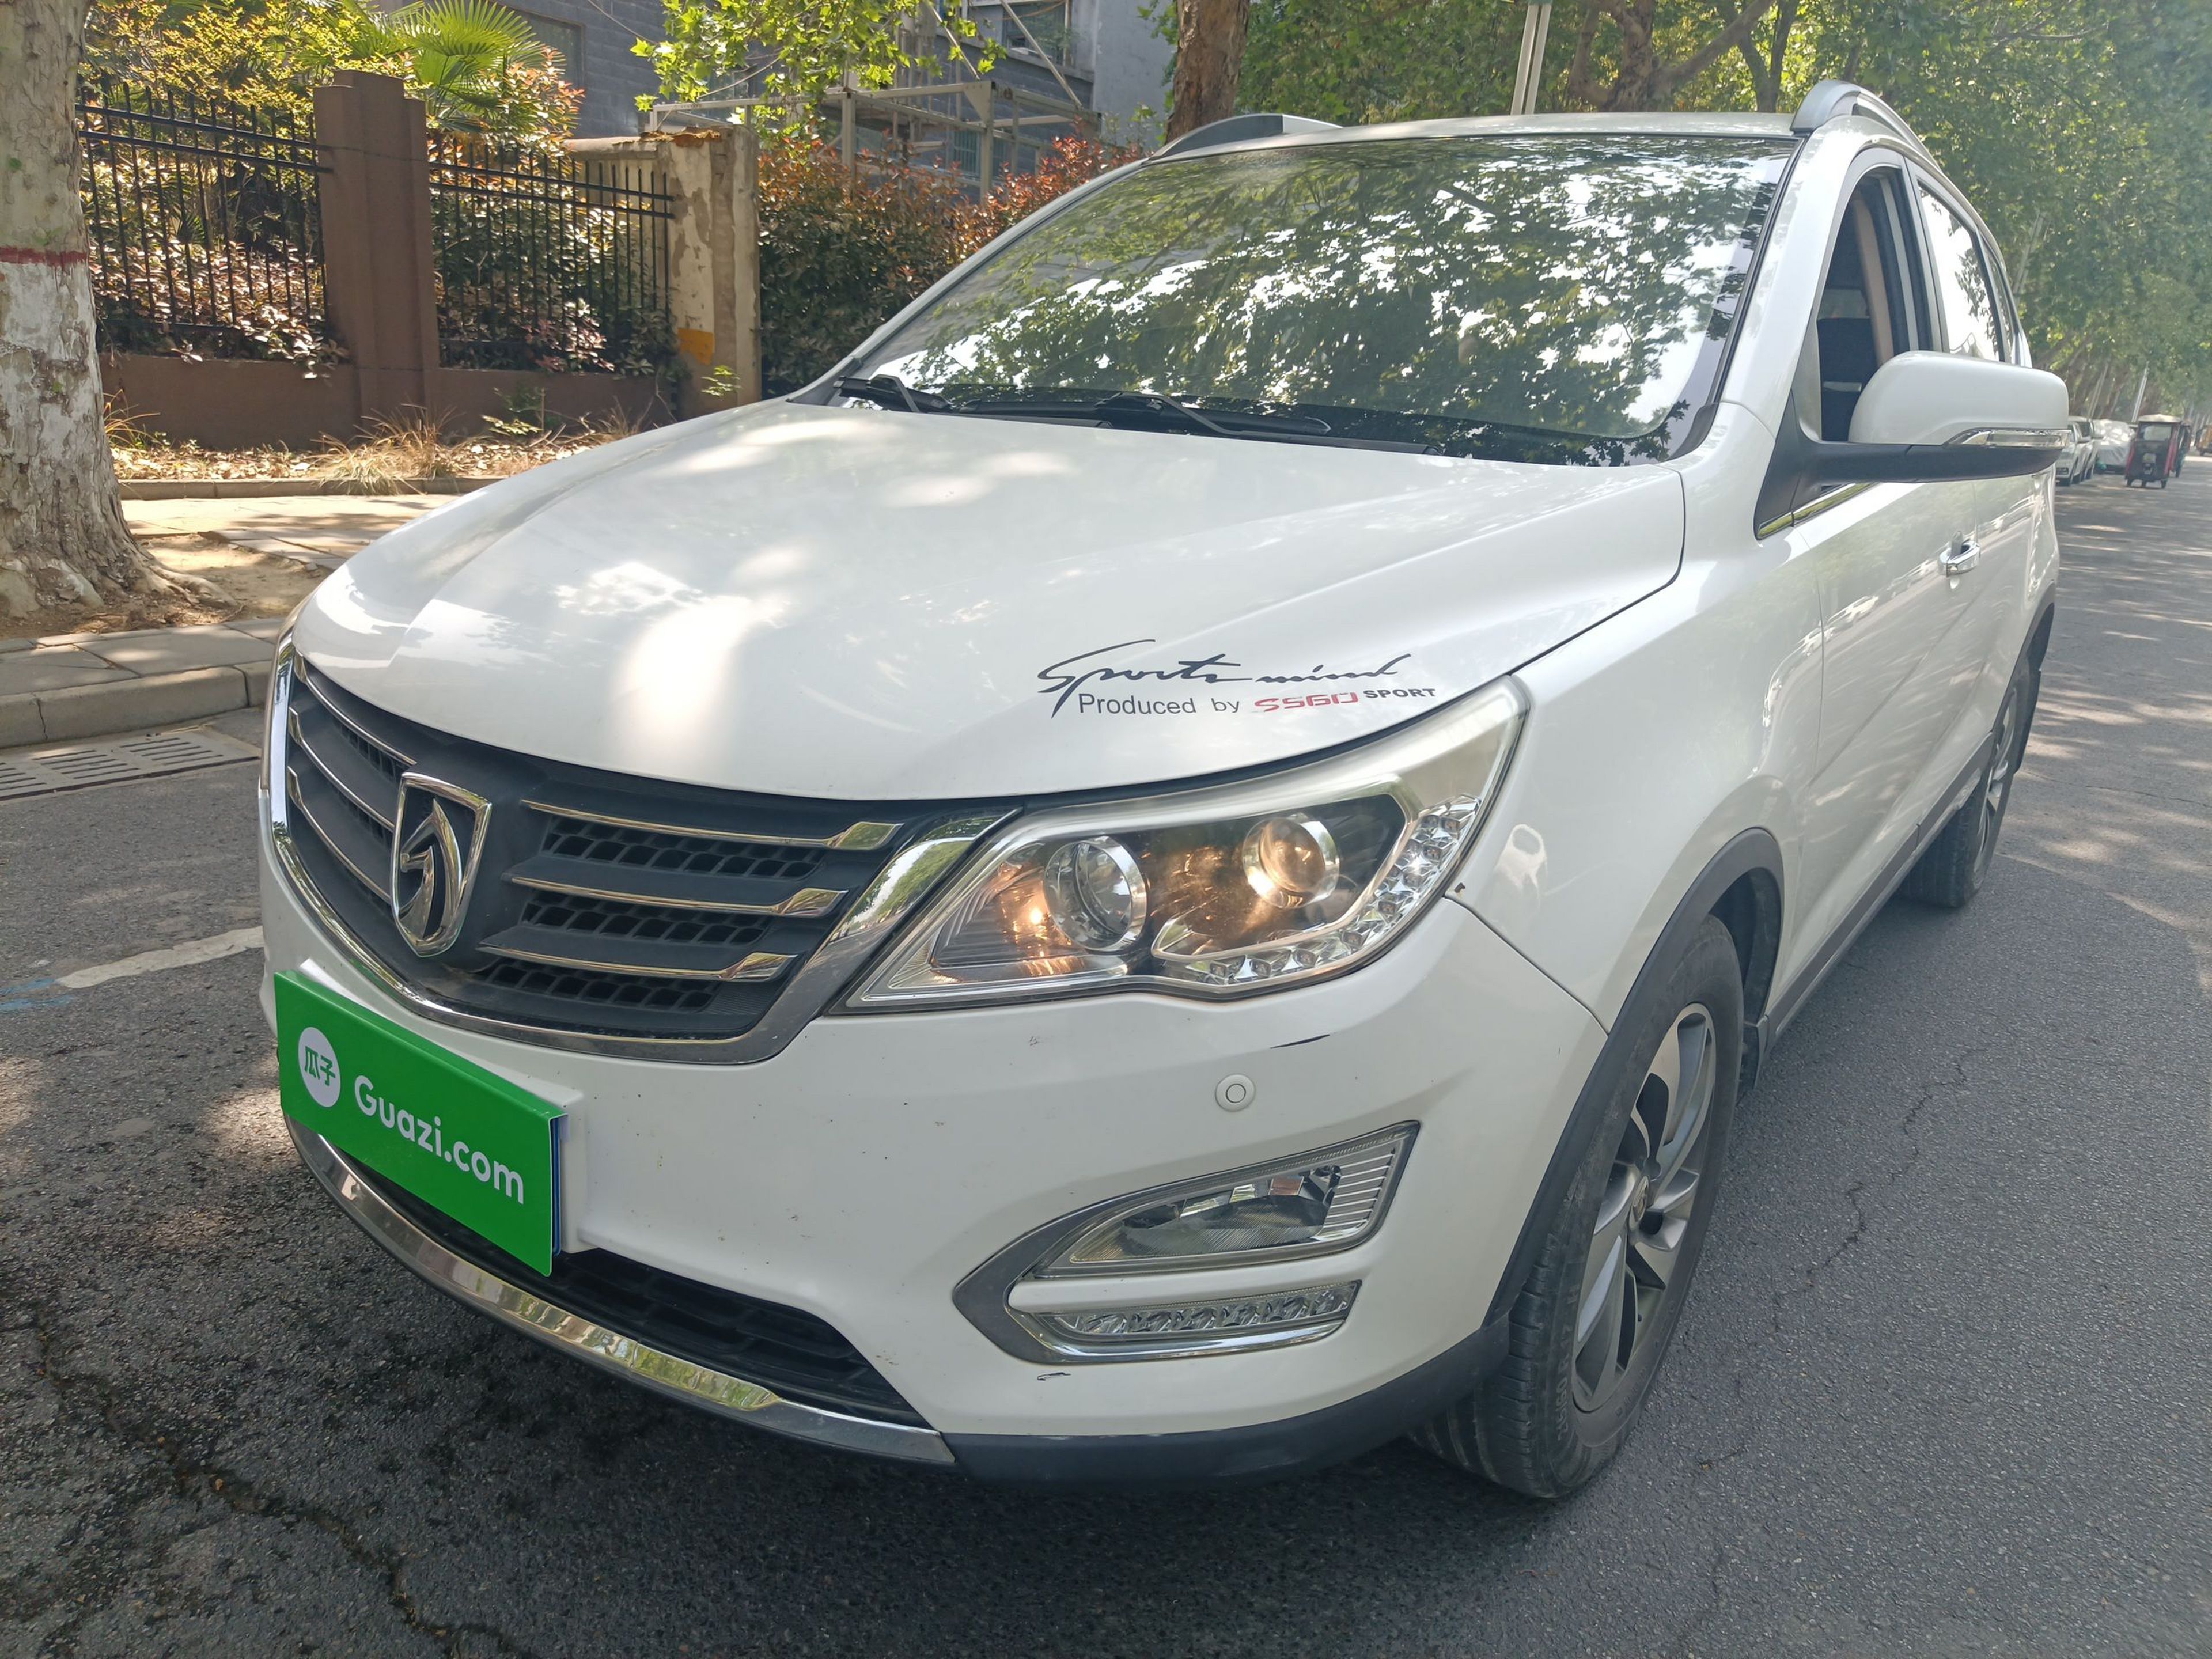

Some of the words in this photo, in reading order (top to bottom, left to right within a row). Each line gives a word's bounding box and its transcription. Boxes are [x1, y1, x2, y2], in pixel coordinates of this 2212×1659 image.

[1078, 693, 1196, 715] Produced
[1211, 698, 1240, 714] by
[1363, 688, 1436, 699] SPORT
[304, 1046, 336, 1086] 瓜子
[354, 1075, 524, 1205] Guazi.com
